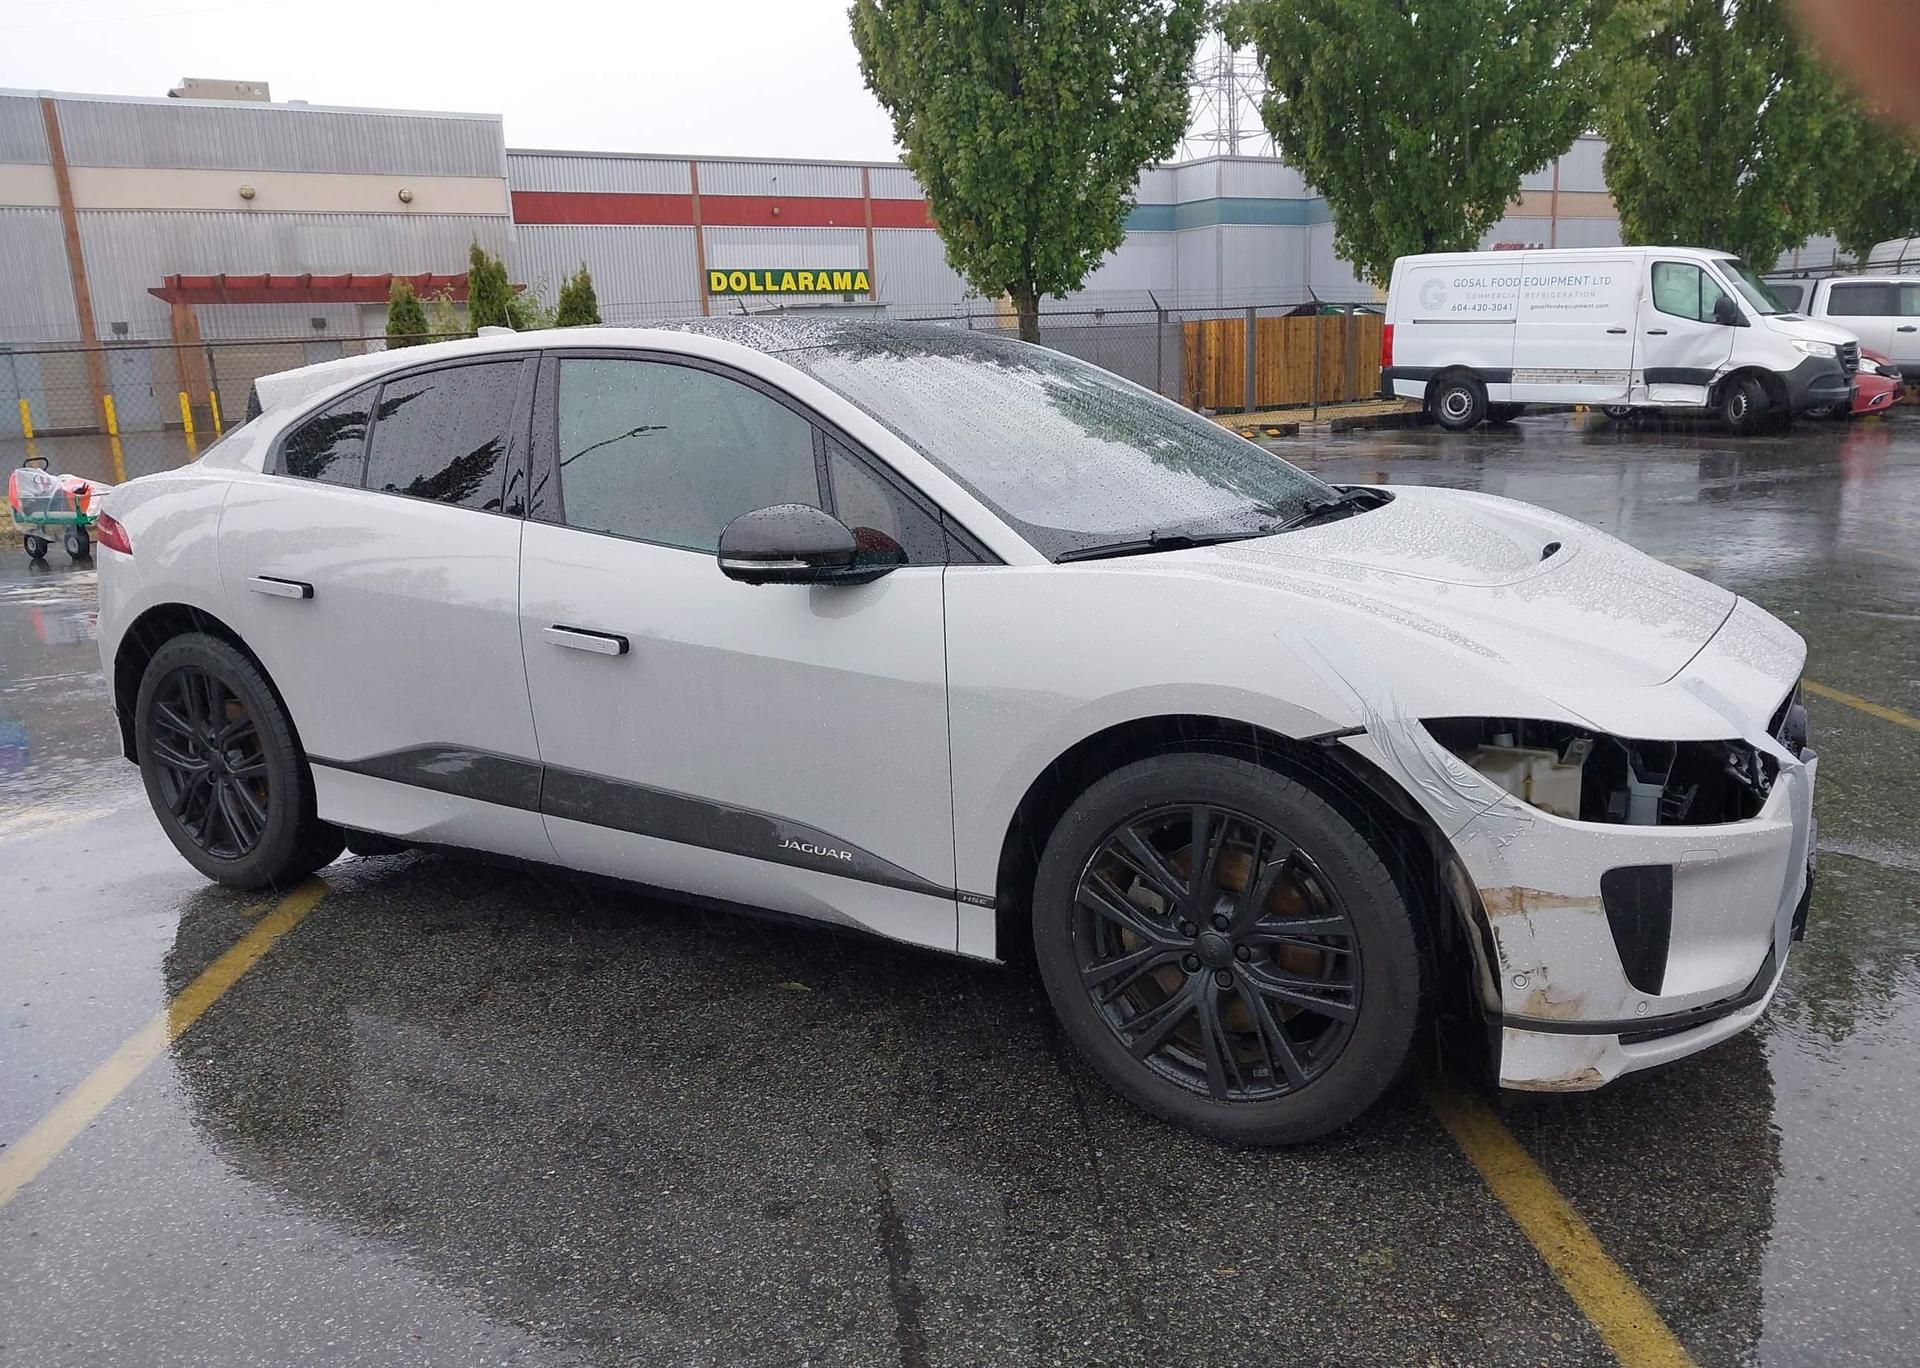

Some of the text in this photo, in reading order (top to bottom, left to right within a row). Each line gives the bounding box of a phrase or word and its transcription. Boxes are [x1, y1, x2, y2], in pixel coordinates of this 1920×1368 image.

[710, 271, 870, 292] DOLLARAMA
[1453, 278, 1488, 288] GOSAL
[1491, 277, 1521, 287] FOOD
[1524, 275, 1590, 287] EQUIPMENT
[1525, 291, 1596, 299] REFRIGERATION
[1451, 303, 1513, 312] 604-430-3041
[777, 839, 853, 861] JAGUAR
[962, 895, 989, 905] HSE
